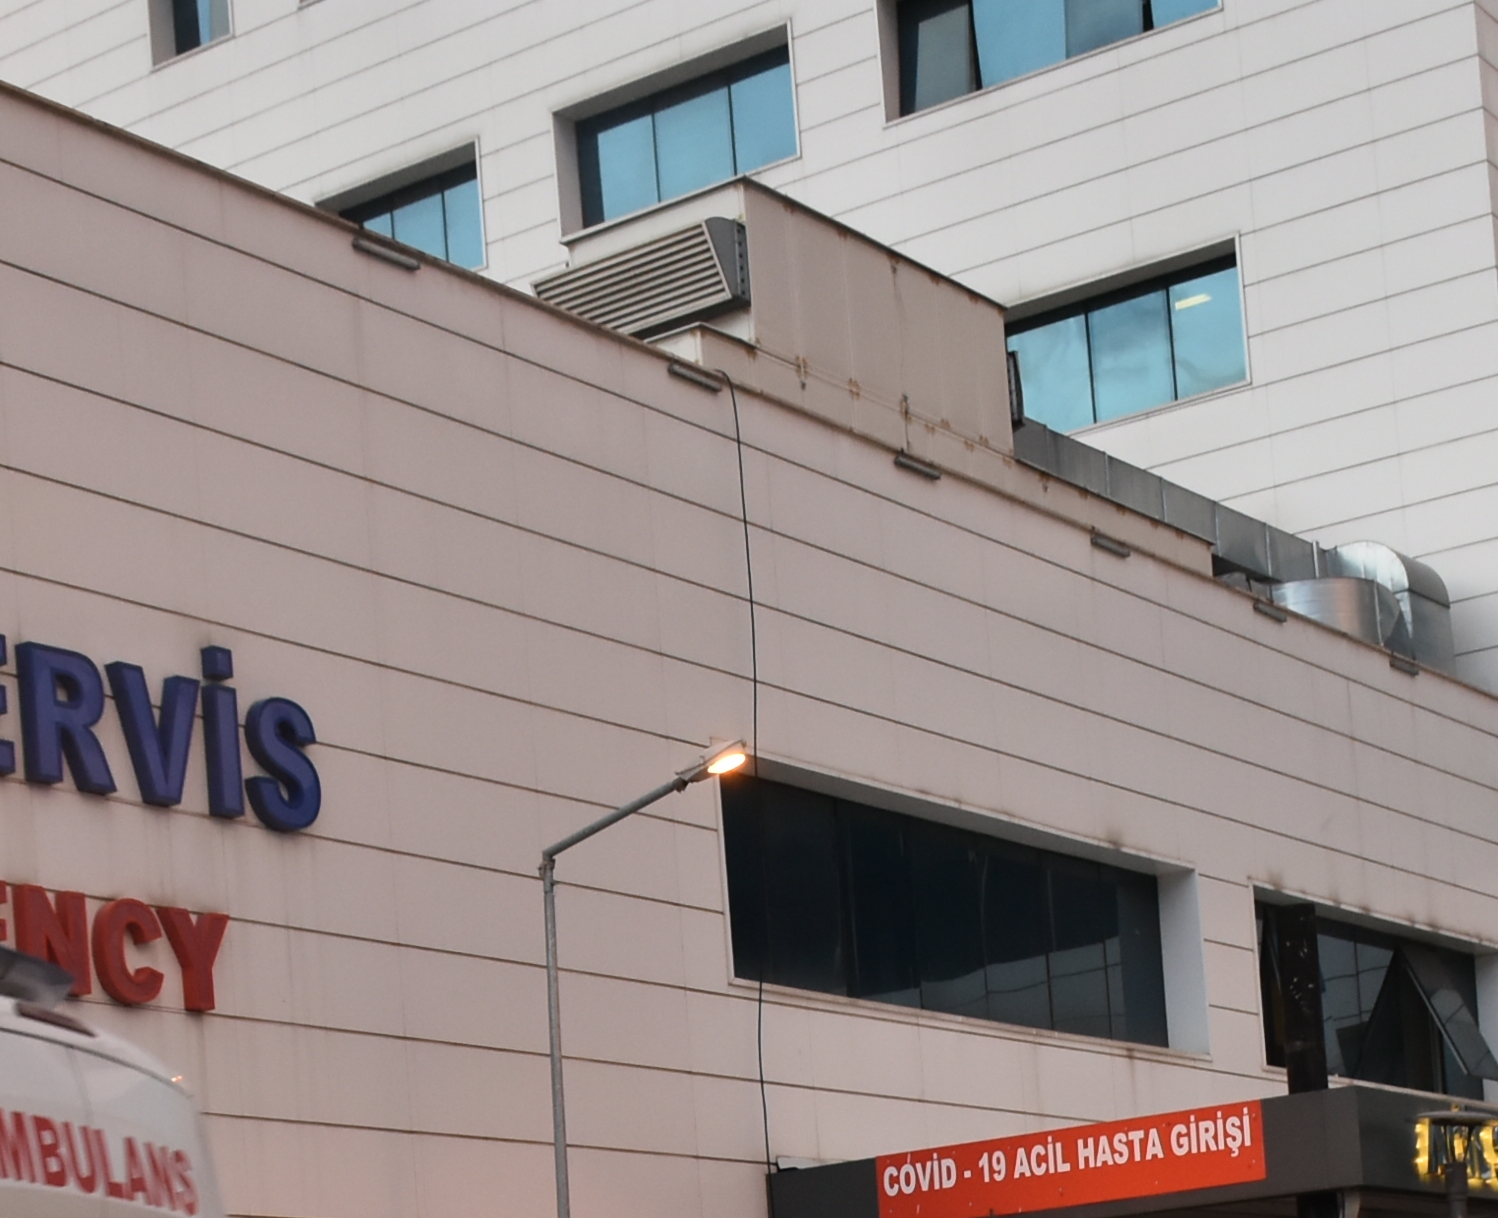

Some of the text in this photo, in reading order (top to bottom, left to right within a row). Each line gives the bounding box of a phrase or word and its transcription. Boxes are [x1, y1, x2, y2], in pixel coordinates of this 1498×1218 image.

[883, 1152, 957, 1197] COVİD
[978, 1150, 1006, 1183] 19
[1014, 1136, 1070, 1179] ACİL
[1077, 1127, 1164, 1169] HASTA
[1170, 1107, 1252, 1157] GİRİŞİ
